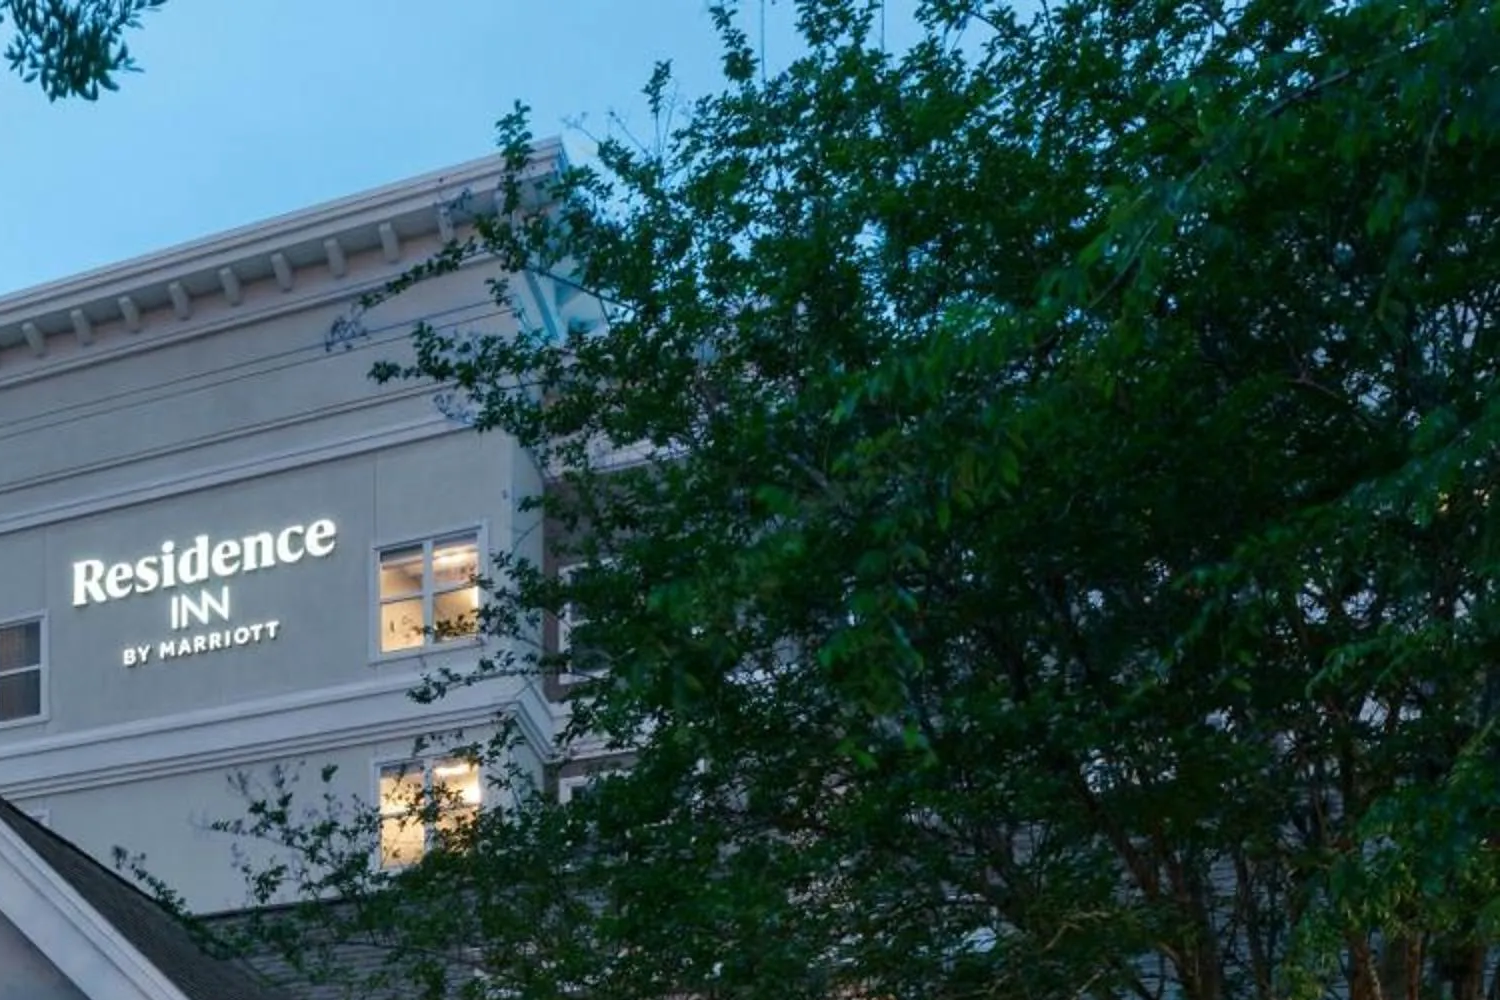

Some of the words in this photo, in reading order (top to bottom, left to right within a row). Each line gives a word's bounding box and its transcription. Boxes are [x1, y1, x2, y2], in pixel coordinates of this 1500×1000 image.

[72, 518, 337, 606] Residence
[170, 585, 231, 630] INN
[122, 647, 151, 666] BY
[158, 620, 281, 659] MARRIOTT
